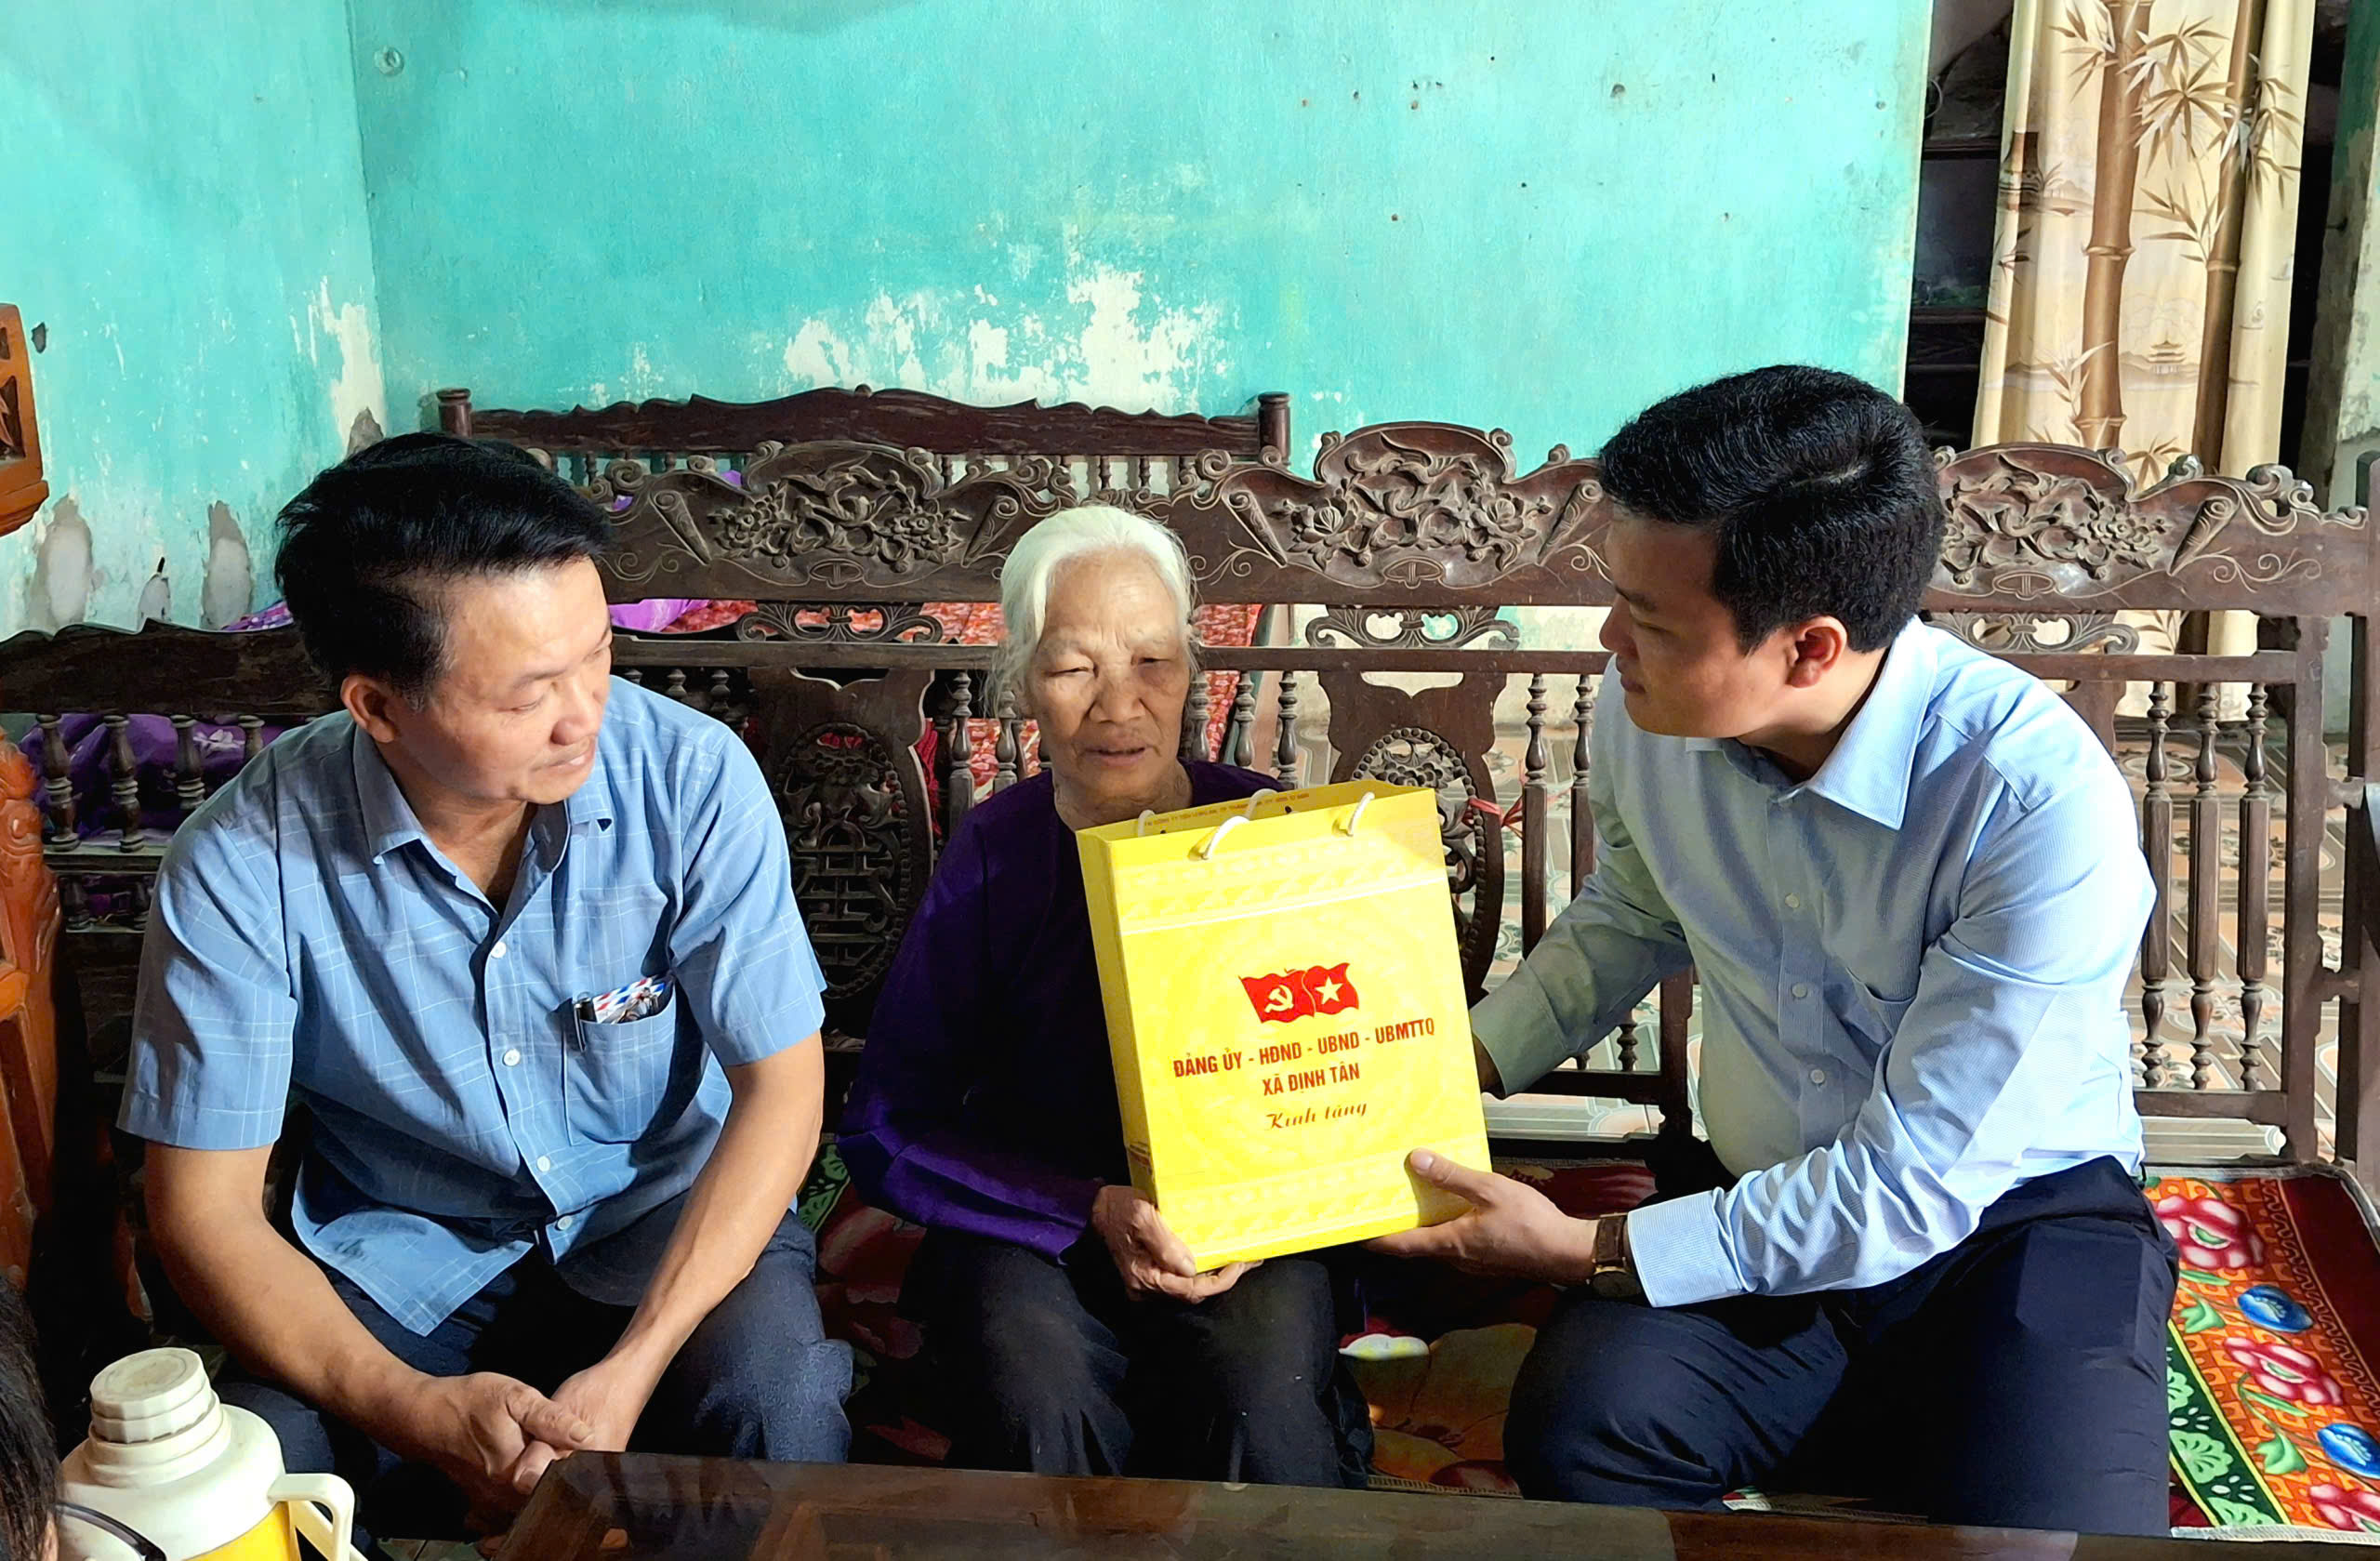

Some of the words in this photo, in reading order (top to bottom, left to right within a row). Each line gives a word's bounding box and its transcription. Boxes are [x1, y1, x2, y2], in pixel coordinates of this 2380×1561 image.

[1173, 1052, 1218, 1078] ĐẢNG
[1223, 1047, 1242, 1070] ỦY
[1259, 1042, 1302, 1065] HĐND
[1317, 1032, 1360, 1054] UBND
[1375, 1017, 1435, 1044] UBMTTQ
[1263, 1073, 1284, 1096] XÃ
[1288, 1069, 1326, 1093] ĐỊNH
[1329, 1061, 1360, 1083] TÂN
